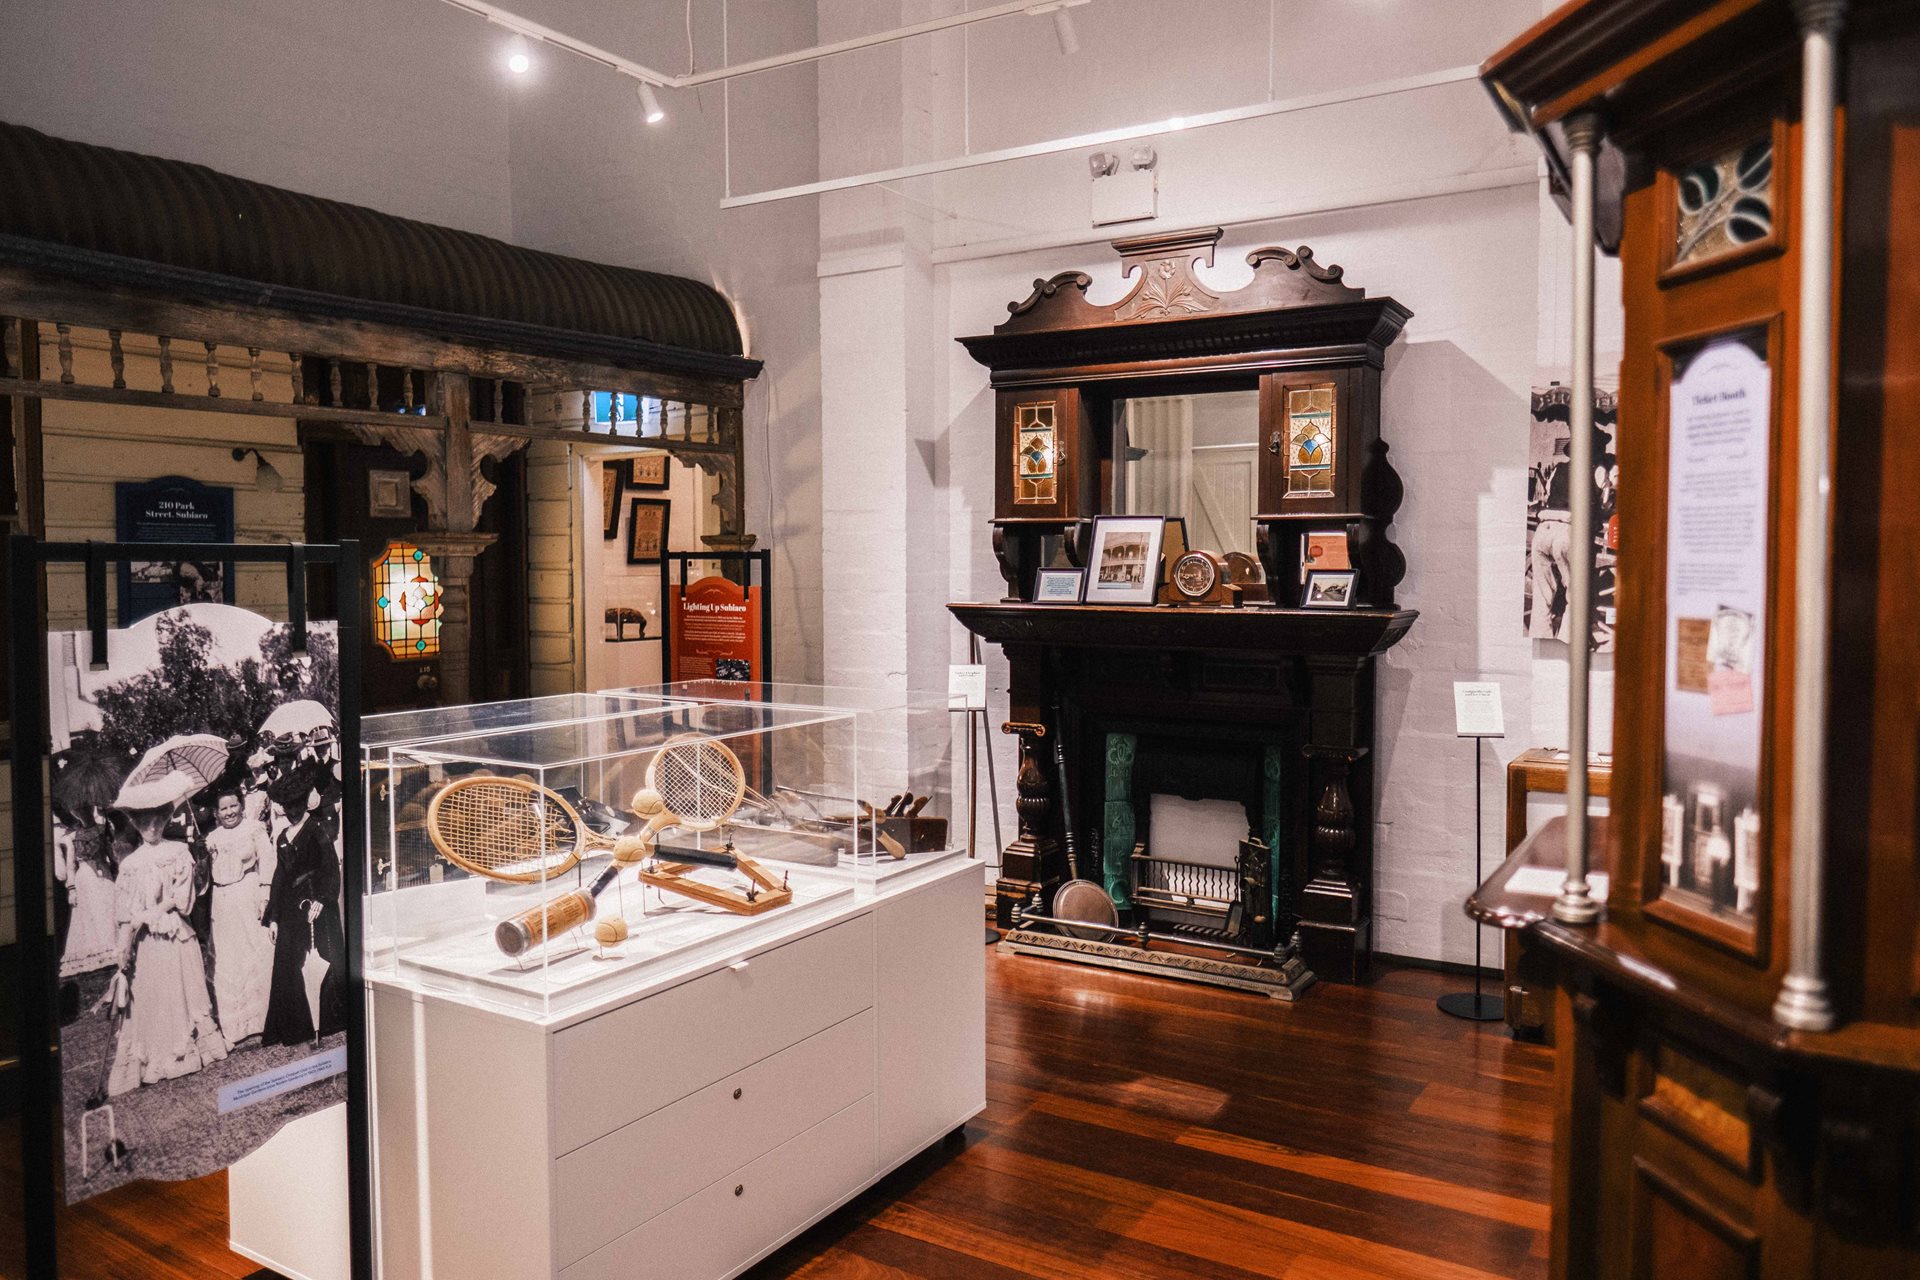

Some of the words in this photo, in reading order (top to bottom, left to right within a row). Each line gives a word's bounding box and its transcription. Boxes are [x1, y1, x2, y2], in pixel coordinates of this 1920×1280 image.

[158, 501, 174, 509] 210
[175, 501, 195, 510] Park
[175, 511, 208, 519] Subiaco
[683, 602, 710, 613] Lighting
[710, 603, 720, 613] Up
[720, 603, 747, 612] Subiaco
